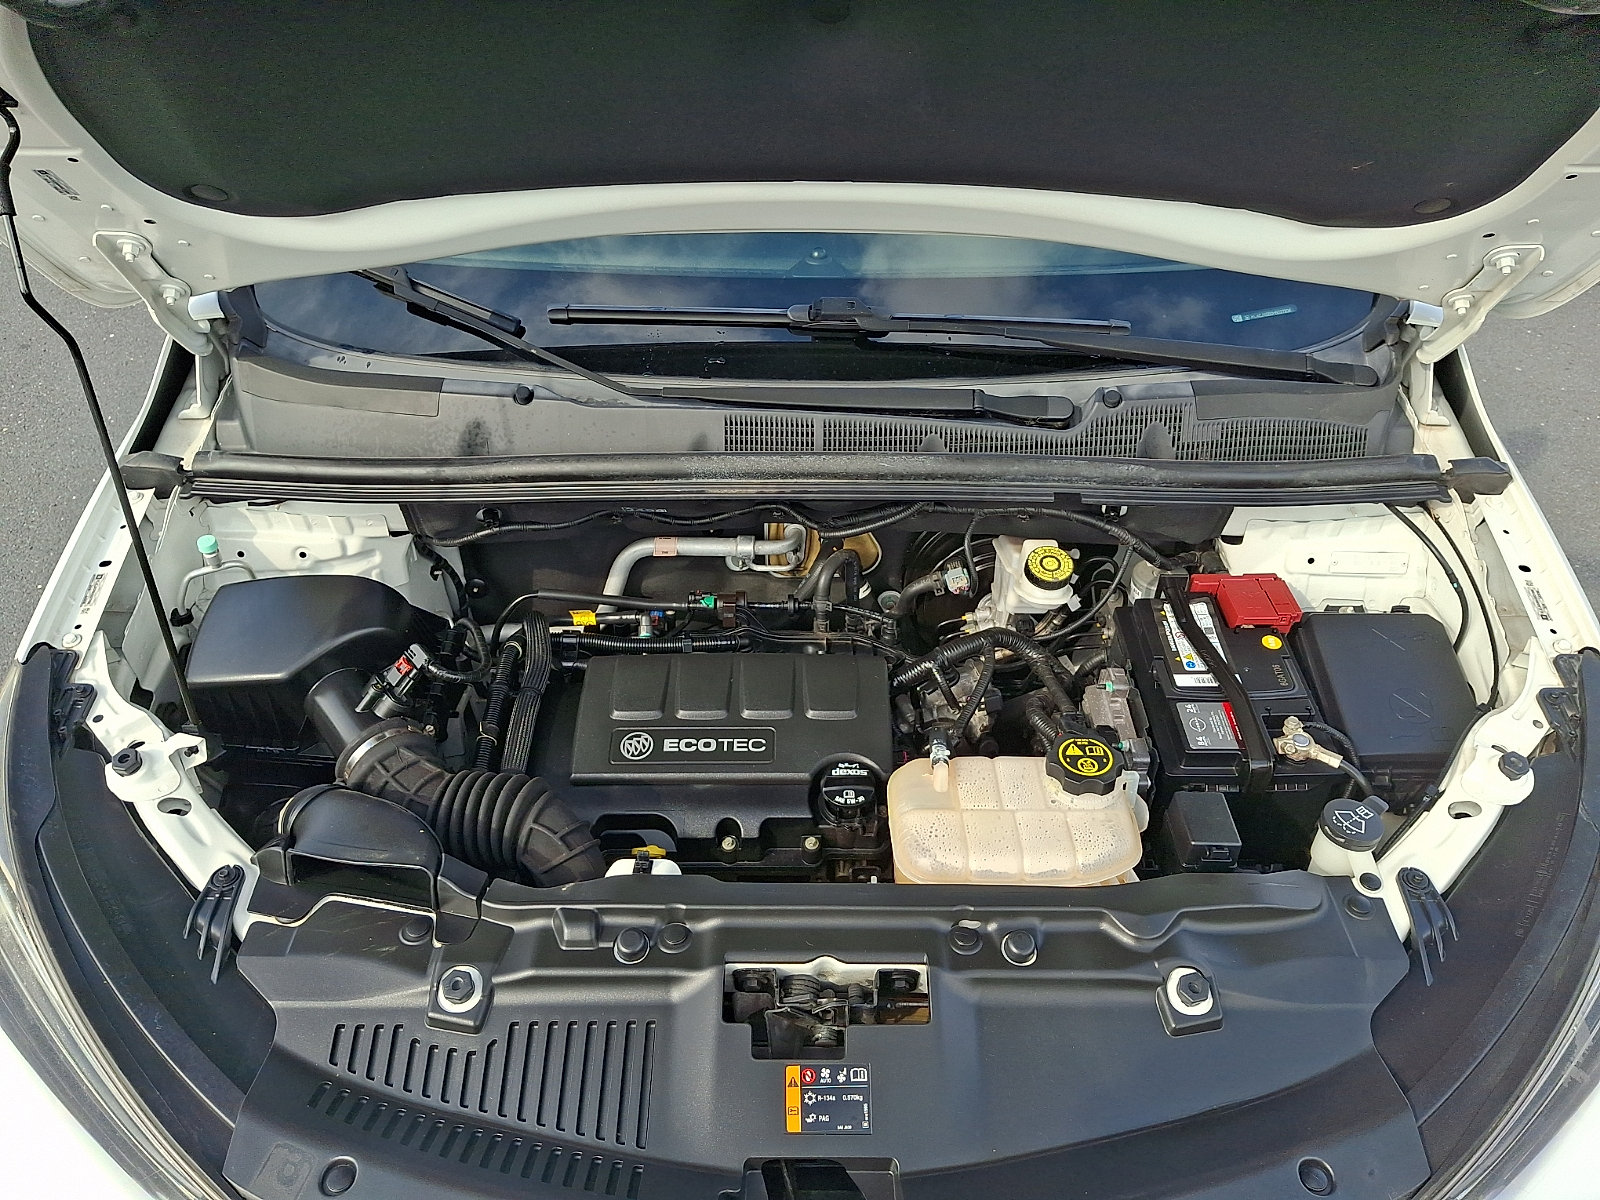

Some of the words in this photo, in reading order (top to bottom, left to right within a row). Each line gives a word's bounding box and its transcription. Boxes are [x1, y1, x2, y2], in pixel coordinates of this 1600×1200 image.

[663, 738, 767, 752] ECOTEC
[1197, 736, 1204, 746] 84
[831, 768, 869, 776] dexos
[834, 795, 845, 804] SAE
